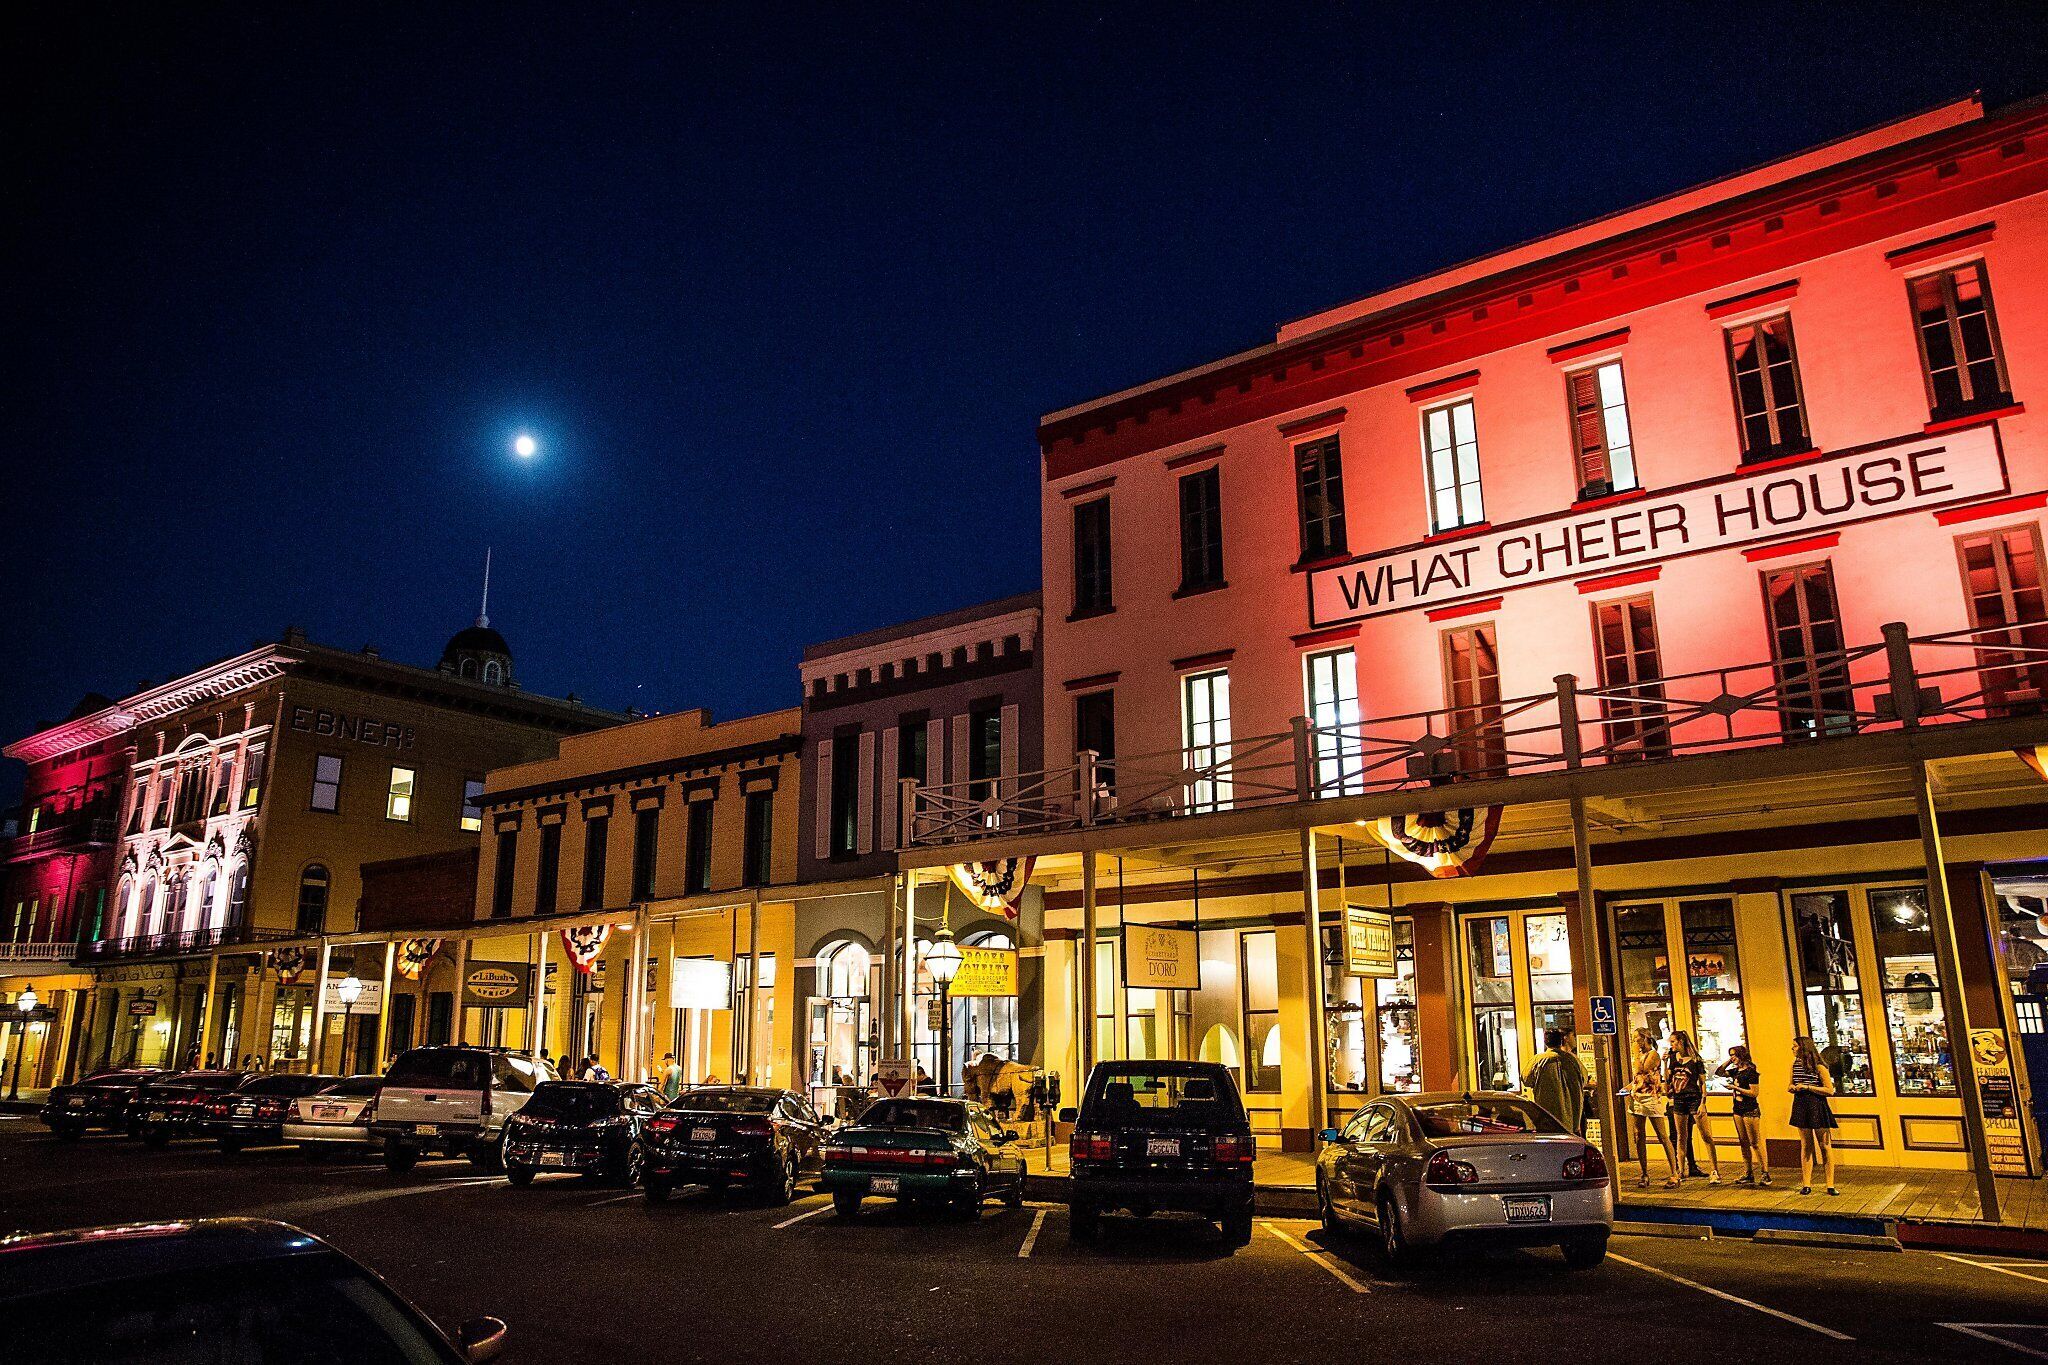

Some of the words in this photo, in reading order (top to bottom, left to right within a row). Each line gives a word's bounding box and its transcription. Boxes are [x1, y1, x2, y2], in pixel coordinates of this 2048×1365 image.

[1338, 545, 1481, 610] WHAT
[1498, 502, 1690, 579] CHEER
[1714, 446, 1954, 538] HOUSE
[1367, 927, 1390, 952] VAULT
[963, 963, 1010, 975] OVELTY
[1149, 962, 1177, 977] D'ORO
[479, 971, 511, 982] LiBush
[475, 987, 511, 997] AFRICA
[1581, 1042, 1594, 1051] VAL
[1976, 1067, 2009, 1077] FEATURED
[1984, 1117, 2019, 1130] SPECIAL
[1509, 1205, 1544, 1216] 7DXU626
